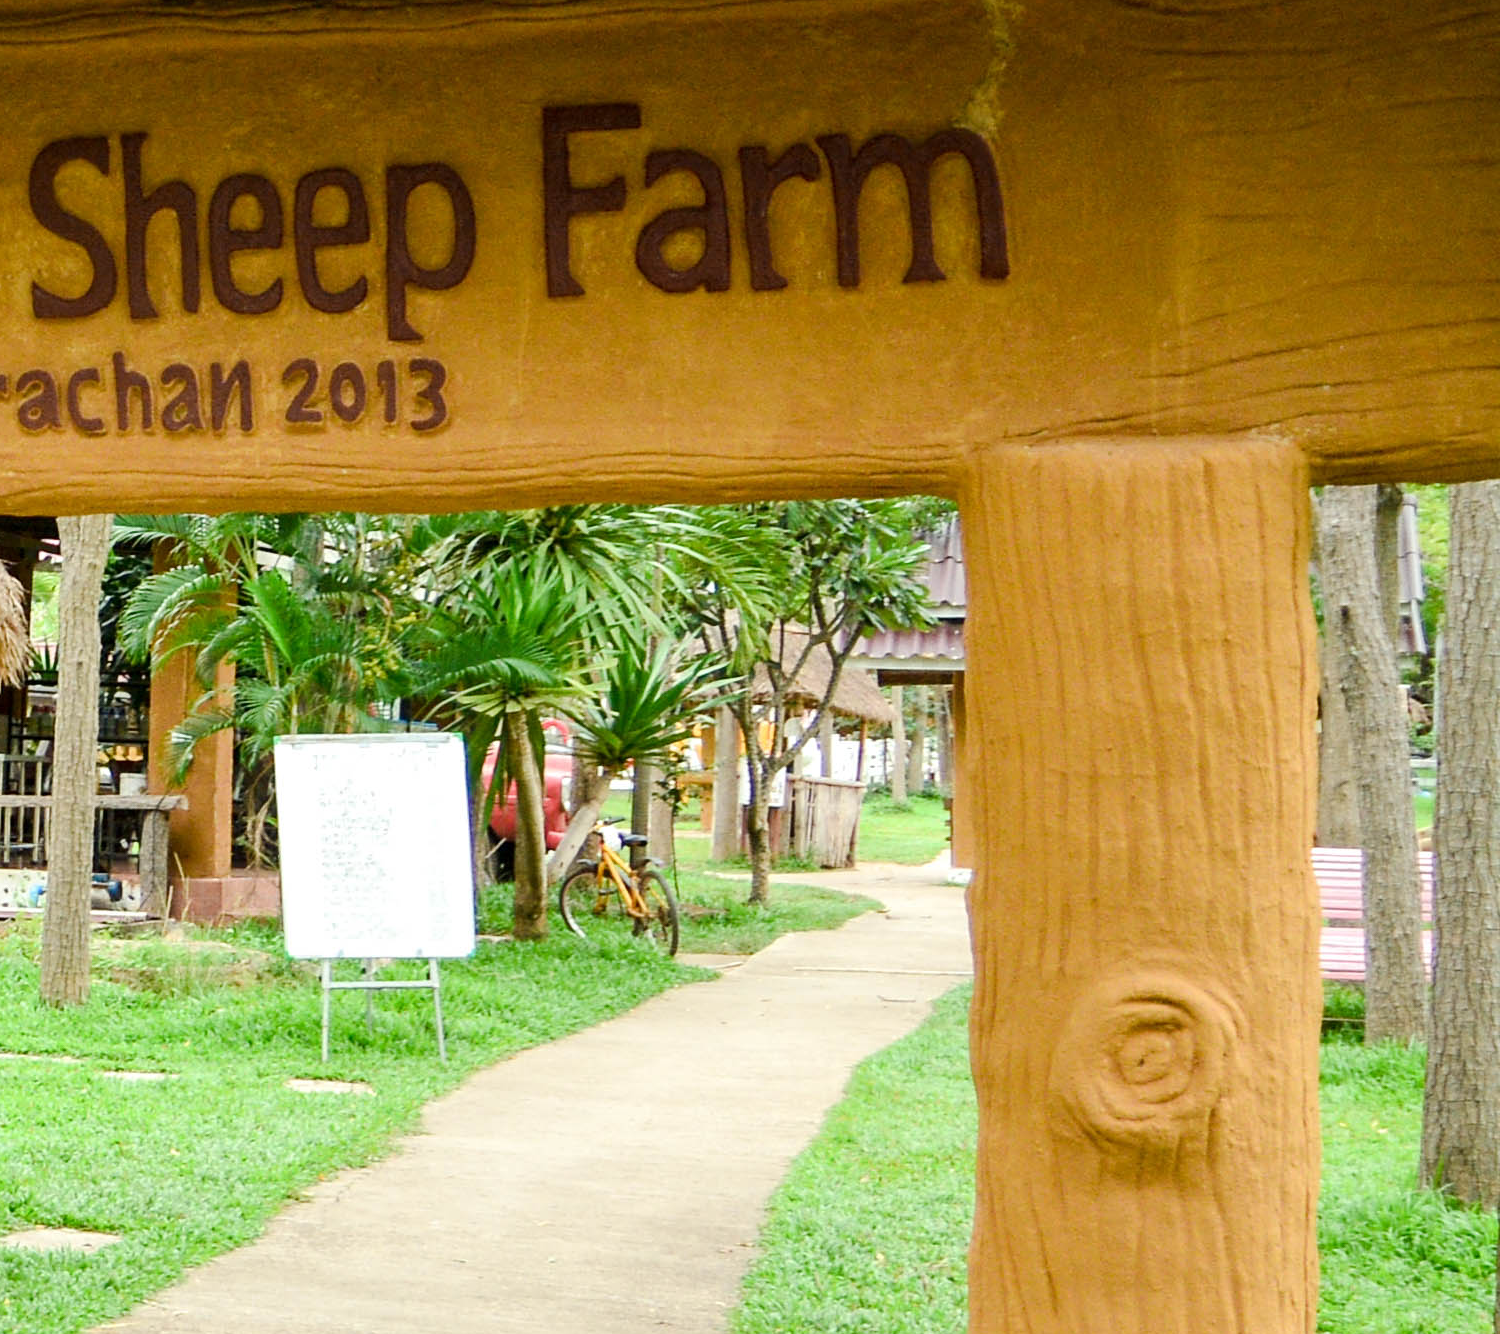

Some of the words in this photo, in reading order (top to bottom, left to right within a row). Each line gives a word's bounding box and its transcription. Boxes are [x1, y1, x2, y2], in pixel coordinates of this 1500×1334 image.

[29, 132, 477, 343] Sheep
[542, 102, 1010, 298] Farm
[281, 357, 449, 433] 2013
